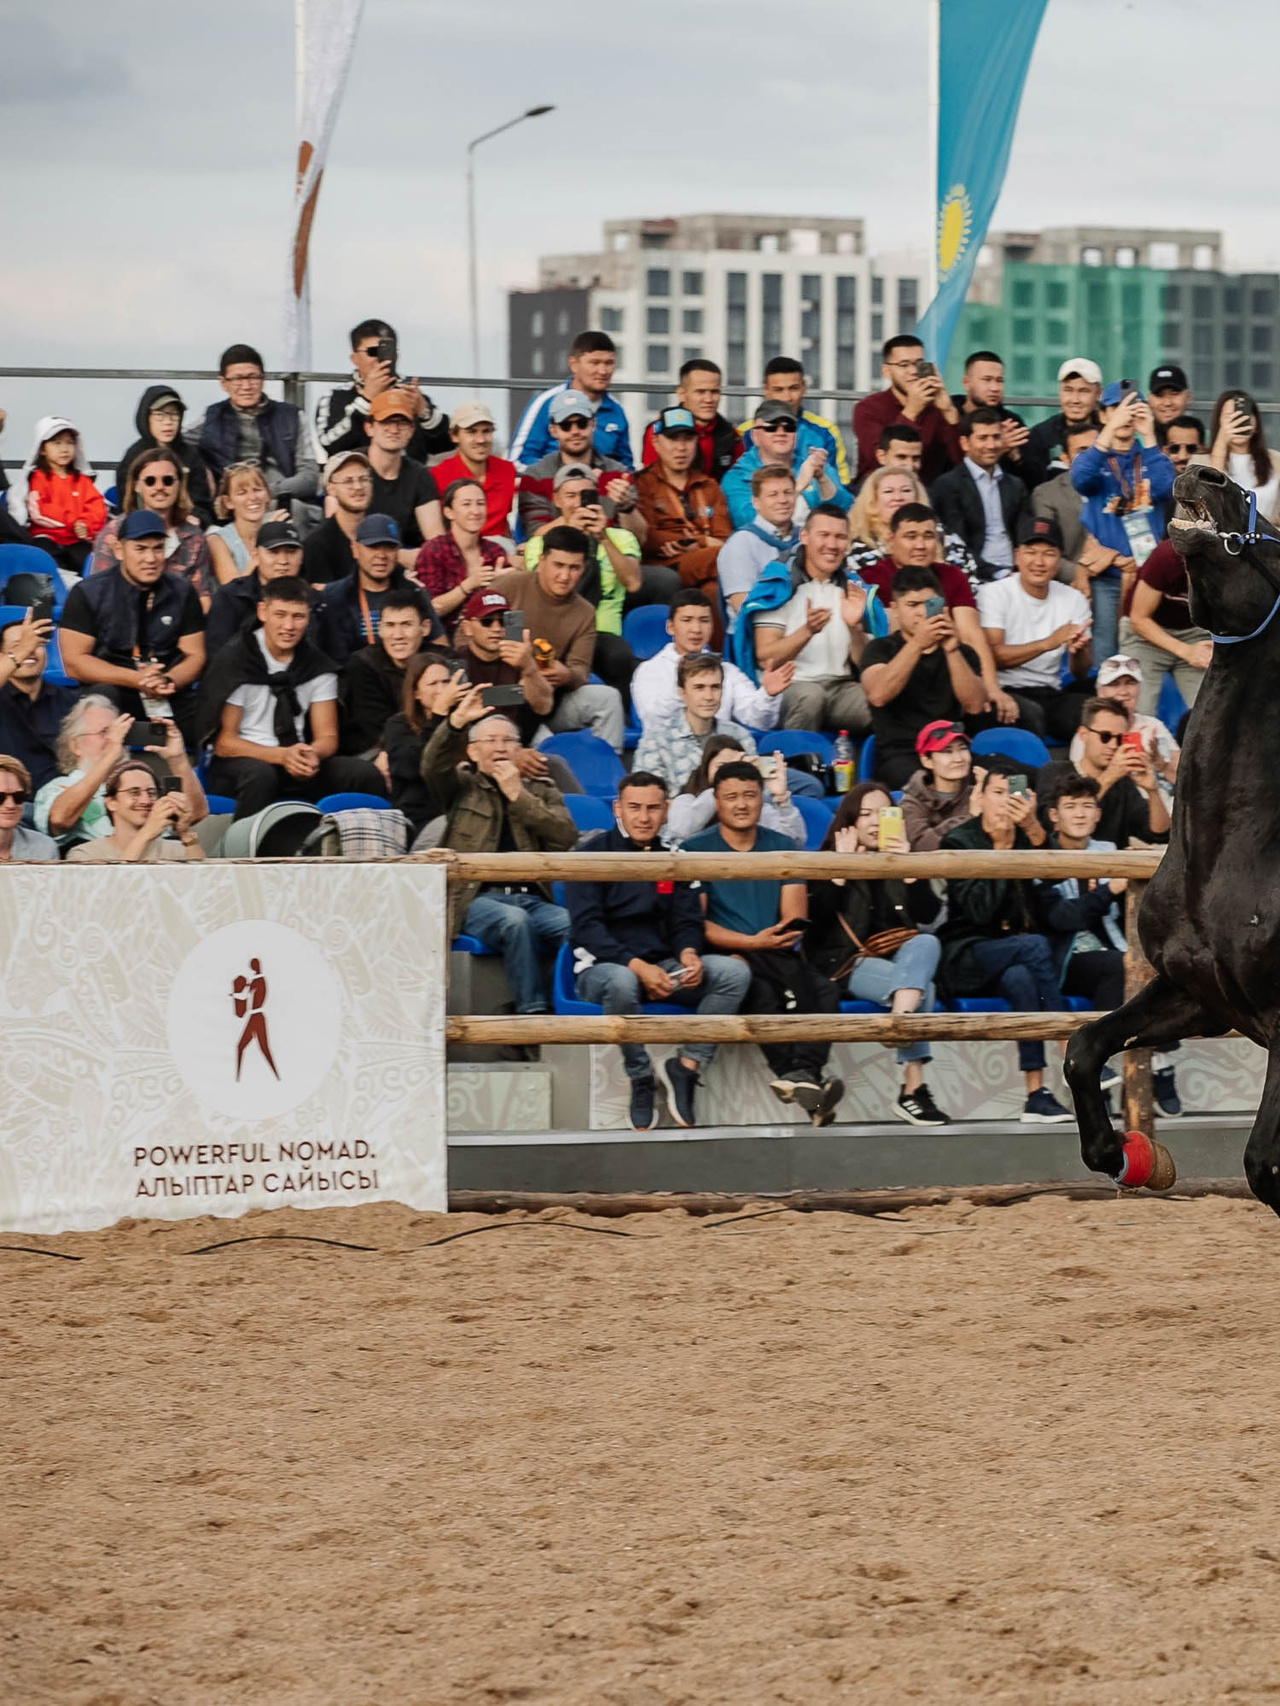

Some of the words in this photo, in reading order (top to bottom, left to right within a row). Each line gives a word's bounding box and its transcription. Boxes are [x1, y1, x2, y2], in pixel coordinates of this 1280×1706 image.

[133, 1142, 271, 1167] POWERFUL
[278, 1139, 376, 1161] NOMAD.
[136, 1173, 254, 1197] АЛЫПТАР
[263, 1164, 380, 1193] САЙЫСЫ
